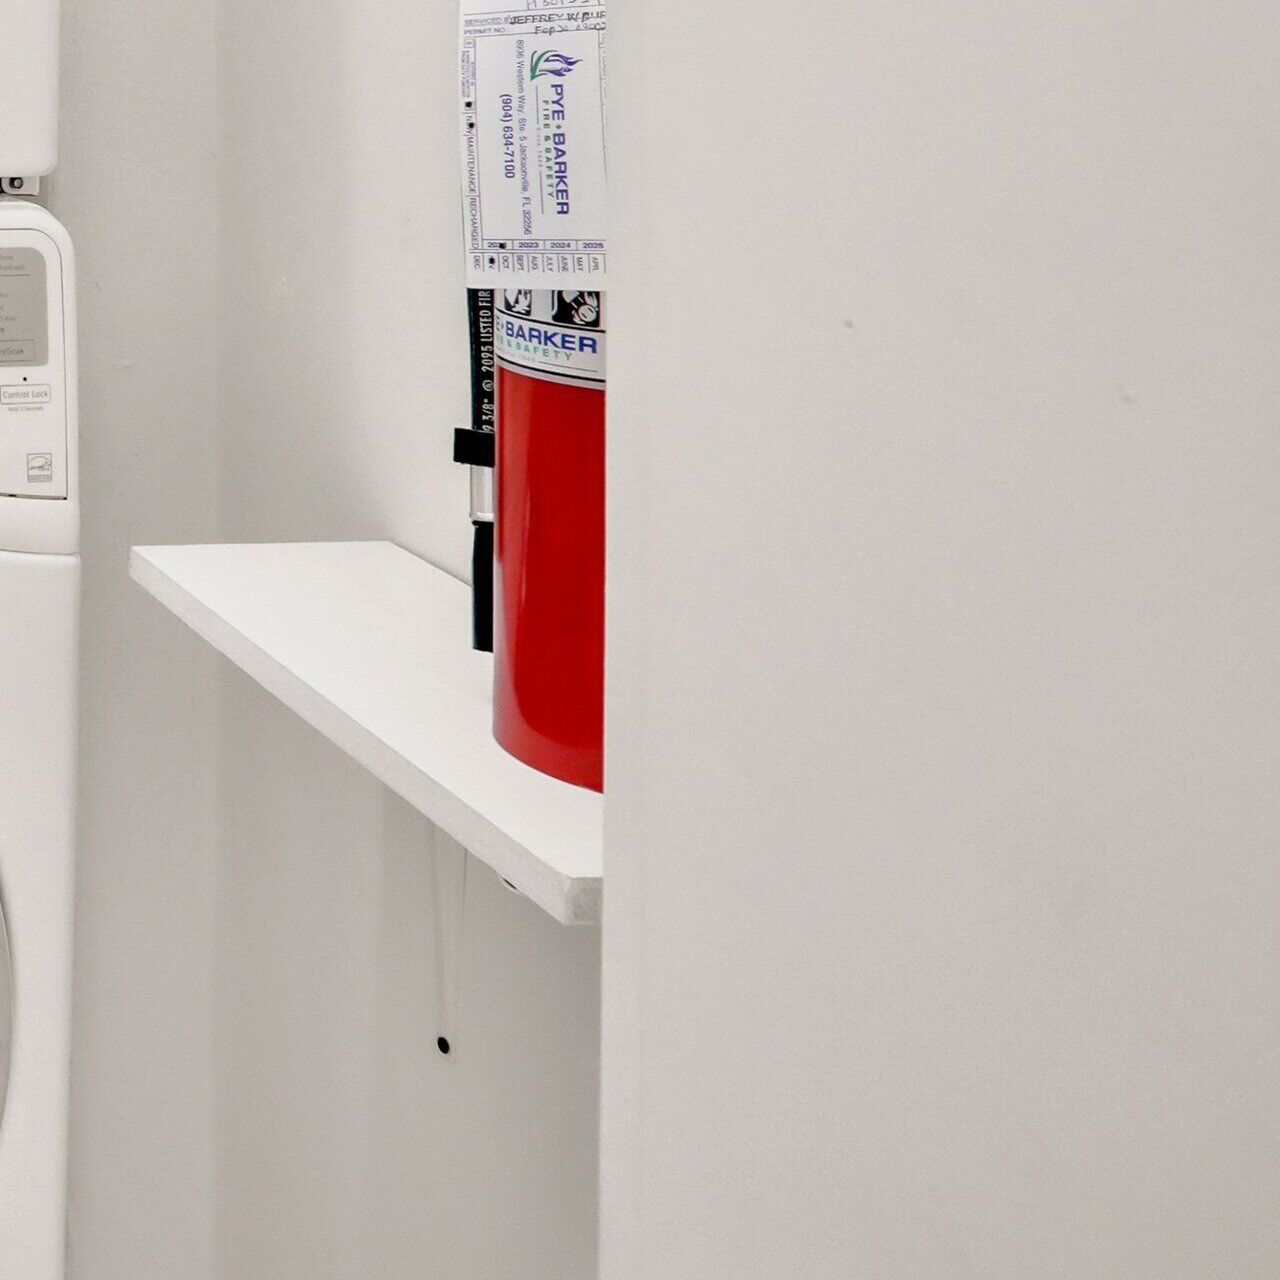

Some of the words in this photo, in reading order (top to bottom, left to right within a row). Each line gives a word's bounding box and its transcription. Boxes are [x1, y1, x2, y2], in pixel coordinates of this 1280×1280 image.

[510, 13, 564, 25] JEFFREY
[499, 94, 513, 122] (904)
[551, 84, 565, 121] PYE
[517, 60, 525, 94] Western
[522, 196, 530, 208] FL
[467, 136, 476, 194] MAINTENANCE
[502, 126, 516, 178] 634-7100
[545, 147, 554, 198] SAFETY
[552, 132, 570, 215] BARKER
[470, 197, 480, 250] RECHARGED
[546, 256, 554, 272] JULY
[576, 257, 584, 271] MAY
[478, 290, 492, 306] FIR
[480, 310, 492, 342] LISTED
[506, 321, 598, 354] BARKER
[481, 345, 494, 372] 2095
[516, 342, 573, 360] SAFETY
[2, 390, 31, 400] Control
